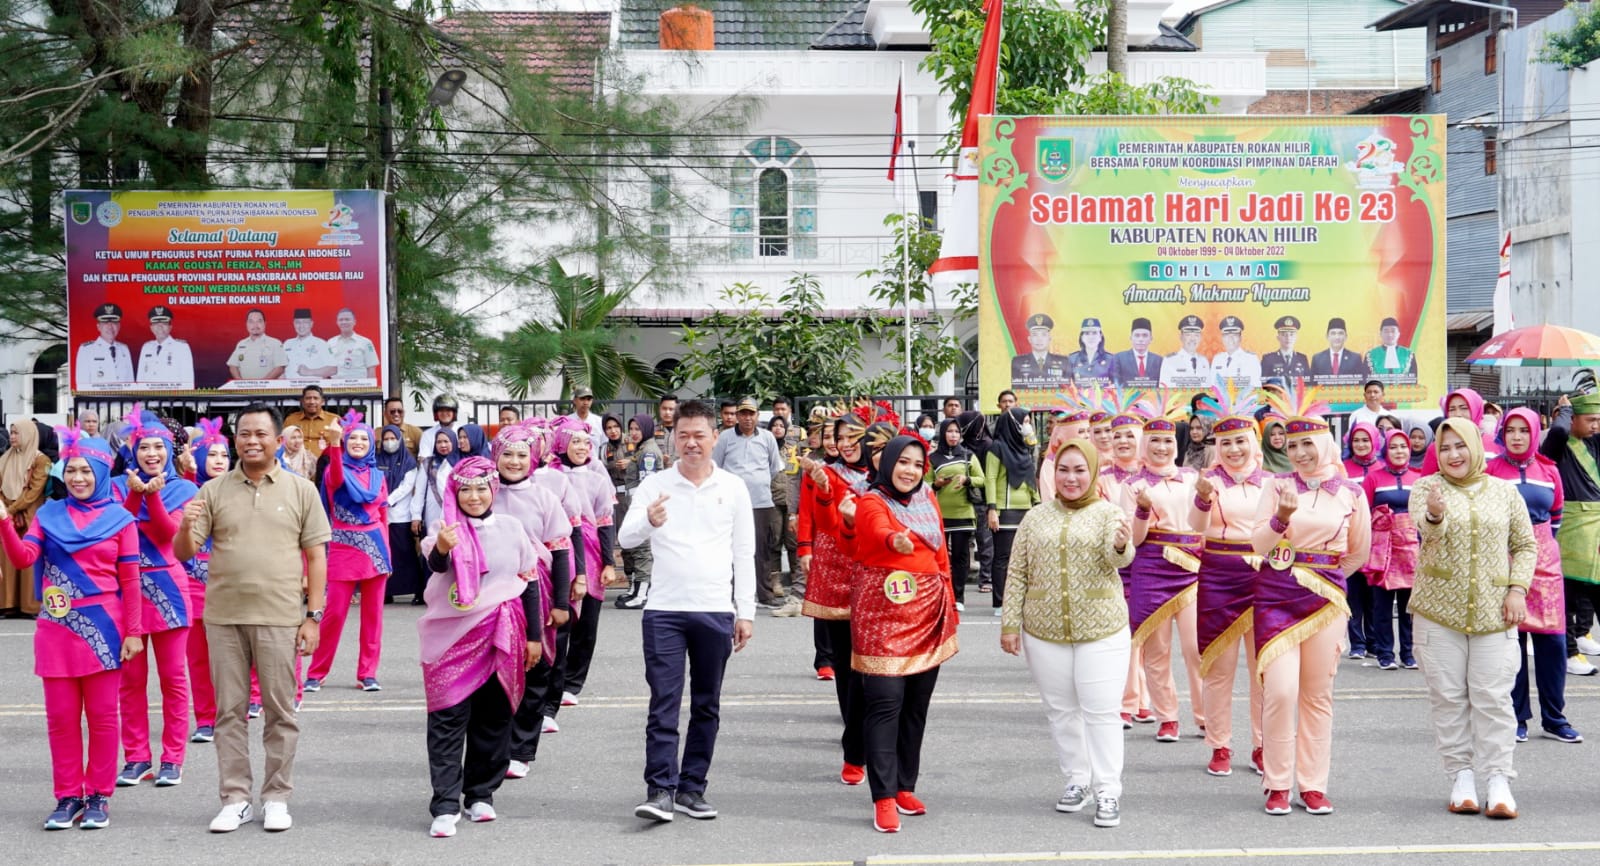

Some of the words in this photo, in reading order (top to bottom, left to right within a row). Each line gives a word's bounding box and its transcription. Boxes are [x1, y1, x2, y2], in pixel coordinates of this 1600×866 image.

[1119, 143, 1183, 153] PEMERINTAH
[1187, 143, 1244, 153] KABUPATEN
[1248, 143, 1281, 153] ROKAN
[1284, 143, 1310, 153] HILIR
[1091, 158, 1139, 168] BERSAMA
[1143, 158, 1179, 167] FORUM
[1182, 157, 1242, 167] KOORDINASI
[1246, 157, 1296, 167] PIMPINAN
[1299, 157, 1337, 167] DAERAH
[1178, 176, 1254, 190] Mengucapkan
[1032, 194, 1156, 223] Selamat
[1166, 193, 1228, 222] Hari
[1239, 193, 1303, 222] Jadi
[1315, 192, 1350, 221] Ke
[1360, 192, 1394, 221] 23
[169, 229, 223, 243] Selamat
[228, 229, 278, 246] Datang
[1111, 228, 1206, 243] KABUPATEN
[1212, 228, 1267, 242] ROKAN
[1274, 227, 1317, 242] HILIR
[152, 251, 195, 259] PENGURUS
[255, 250, 306, 258] PASKIBRAKA
[308, 250, 350, 258] INDONESIA
[1158, 247, 1167, 256] 04
[1169, 247, 1198, 256] Oktober
[1200, 247, 1217, 256] 1999
[1224, 247, 1234, 255] 04
[1235, 247, 1264, 255] Oktober
[1267, 246, 1284, 255] 2022
[146, 262, 180, 270] KAKAK
[227, 261, 264, 270] FERIZA,
[1151, 265, 1210, 276] ROHIL
[1226, 265, 1279, 276] AMAN
[83, 274, 100, 282] DAN
[102, 274, 128, 282] KETUA
[131, 273, 174, 282] PENGURUS
[177, 273, 214, 282] PROVINSI
[217, 273, 244, 281] PURNA
[247, 273, 297, 281] PASKIBRAKA
[299, 272, 342, 281] INDONESIA
[345, 272, 363, 280] RIAU
[144, 285, 178, 294] KAKAK
[209, 284, 283, 293] WERDIANSYAH,
[179, 296, 227, 304] KABUPATEN
[229, 296, 257, 304] ROKAN
[259, 296, 280, 304] HILIR
[1123, 284, 1186, 304] Amanah,
[1190, 284, 1248, 302] Makmur
[1251, 283, 1310, 307] Nyaman
[1273, 546, 1290, 562] 10
[891, 580, 912, 594] 11
[48, 594, 67, 608] 13
